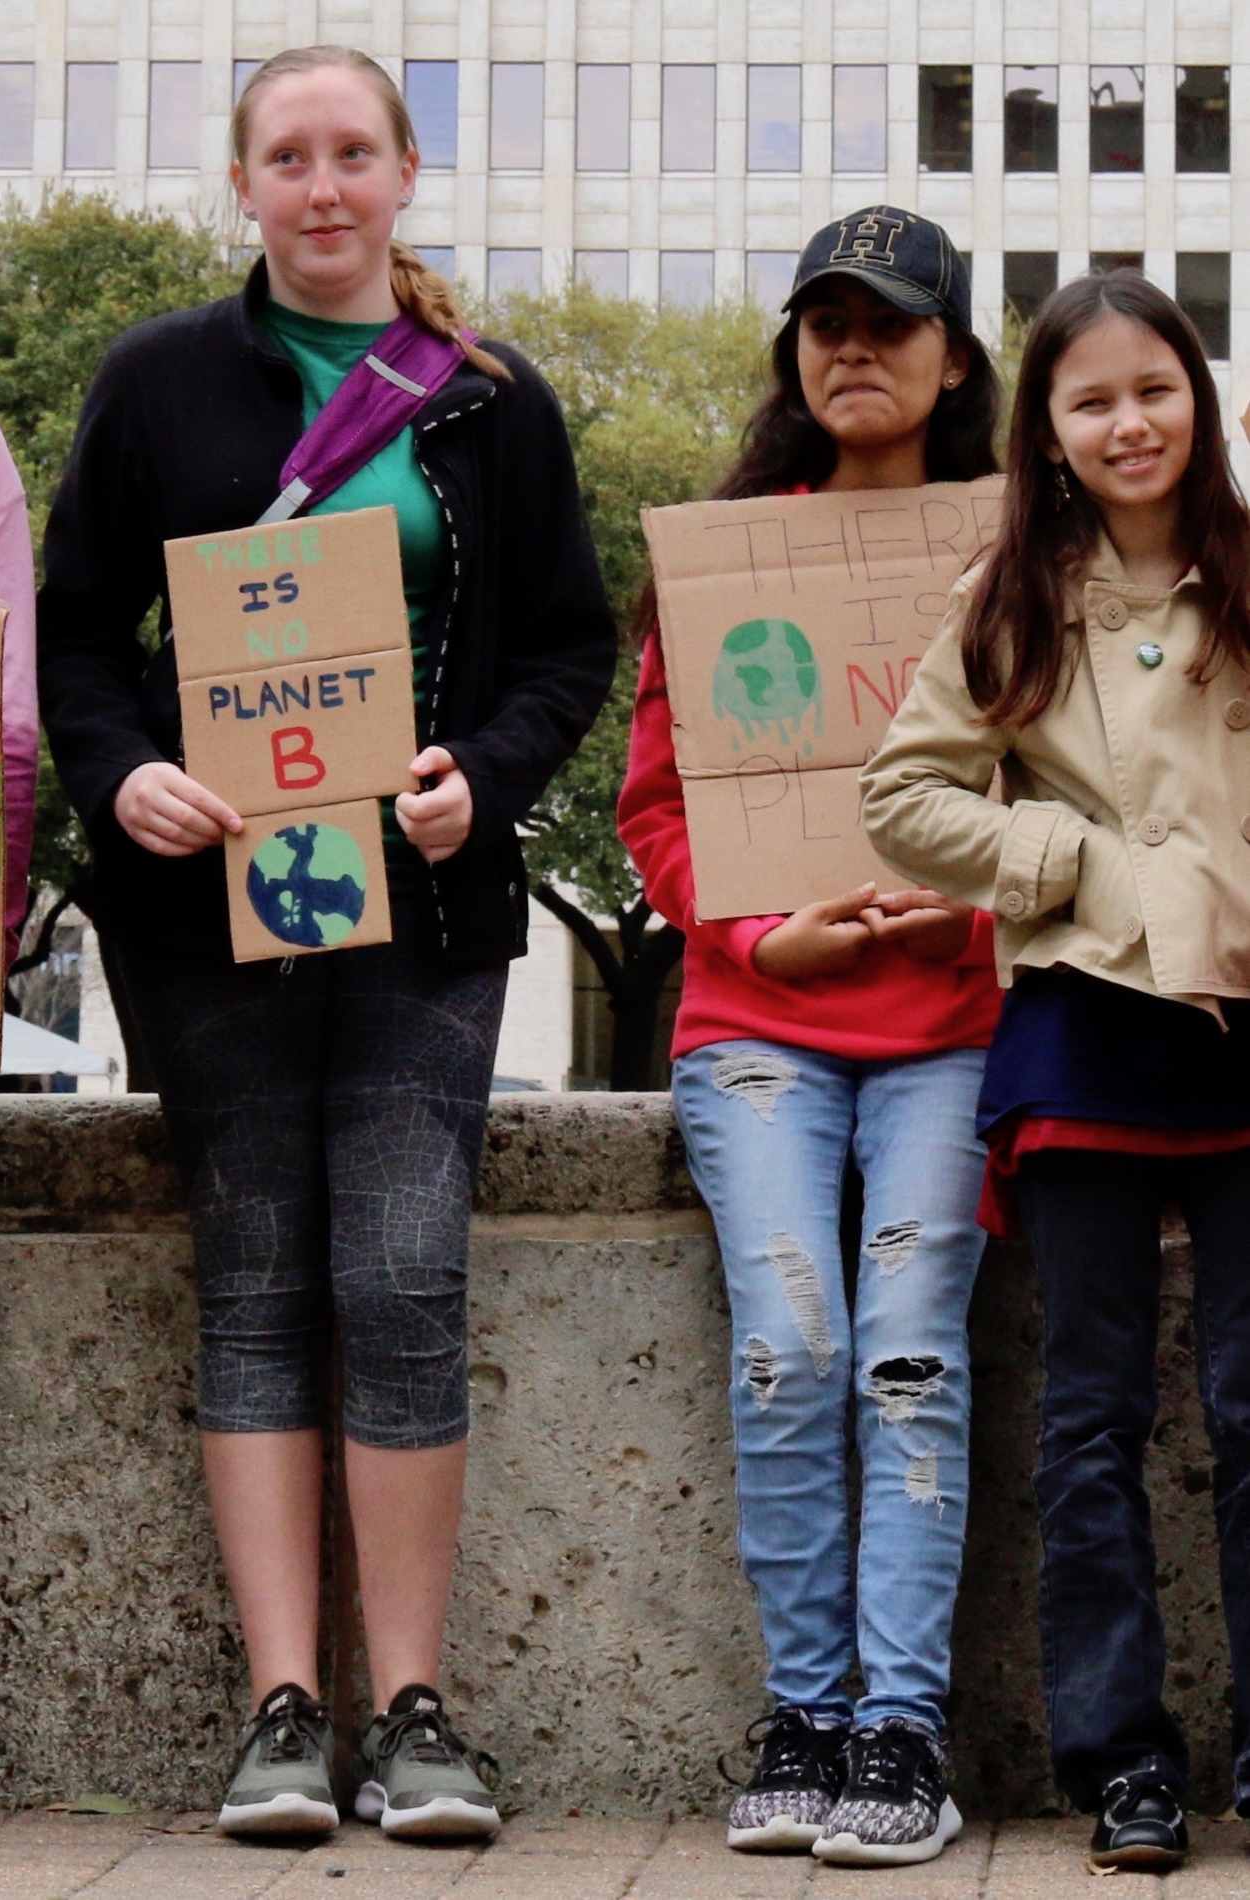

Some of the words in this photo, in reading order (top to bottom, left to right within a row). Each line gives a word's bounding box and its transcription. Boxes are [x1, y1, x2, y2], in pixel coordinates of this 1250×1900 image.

[829, 213, 903, 265] H
[195, 526, 323, 573] THERE
[238, 572, 299, 612] IS
[246, 620, 309, 661] NO
[209, 668, 375, 721] PLANET
[270, 726, 326, 790] B
